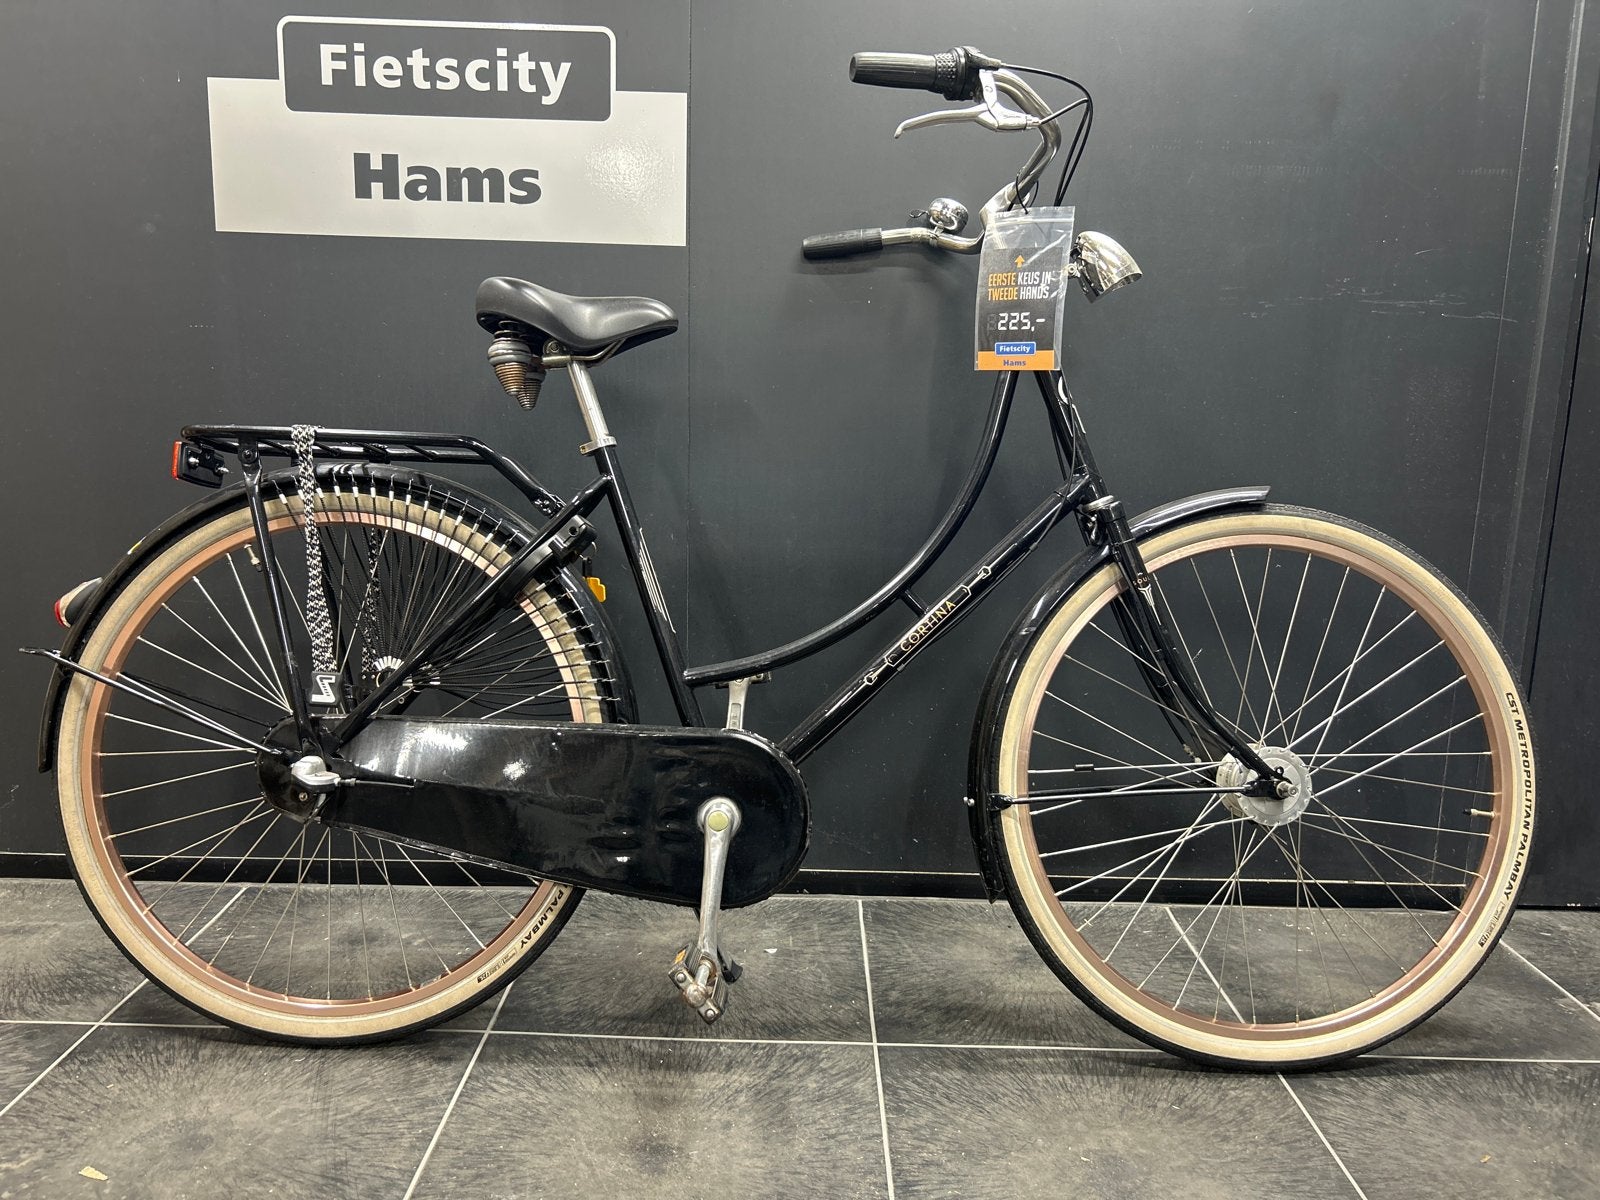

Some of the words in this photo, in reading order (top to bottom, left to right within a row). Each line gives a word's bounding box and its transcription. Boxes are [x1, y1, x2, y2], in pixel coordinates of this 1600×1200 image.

[320, 42, 572, 105] Fietscity
[353, 152, 542, 204] Hams
[987, 287, 1018, 301] TWEEDE
[1019, 285, 1050, 300] HANDS
[988, 273, 1016, 286] EERSTE
[1017, 271, 1040, 285] KEUS
[1041, 271, 1052, 285] IN
[999, 345, 1031, 354] Fietscity
[1003, 359, 1026, 367] Hams
[900, 599, 957, 652] CORTINA
[1505, 692, 1520, 715] CST
[1514, 719, 1532, 830] METROPOLITAN
[1503, 833, 1529, 900] PALMBAY
[520, 889, 565, 949] PALMBAY
